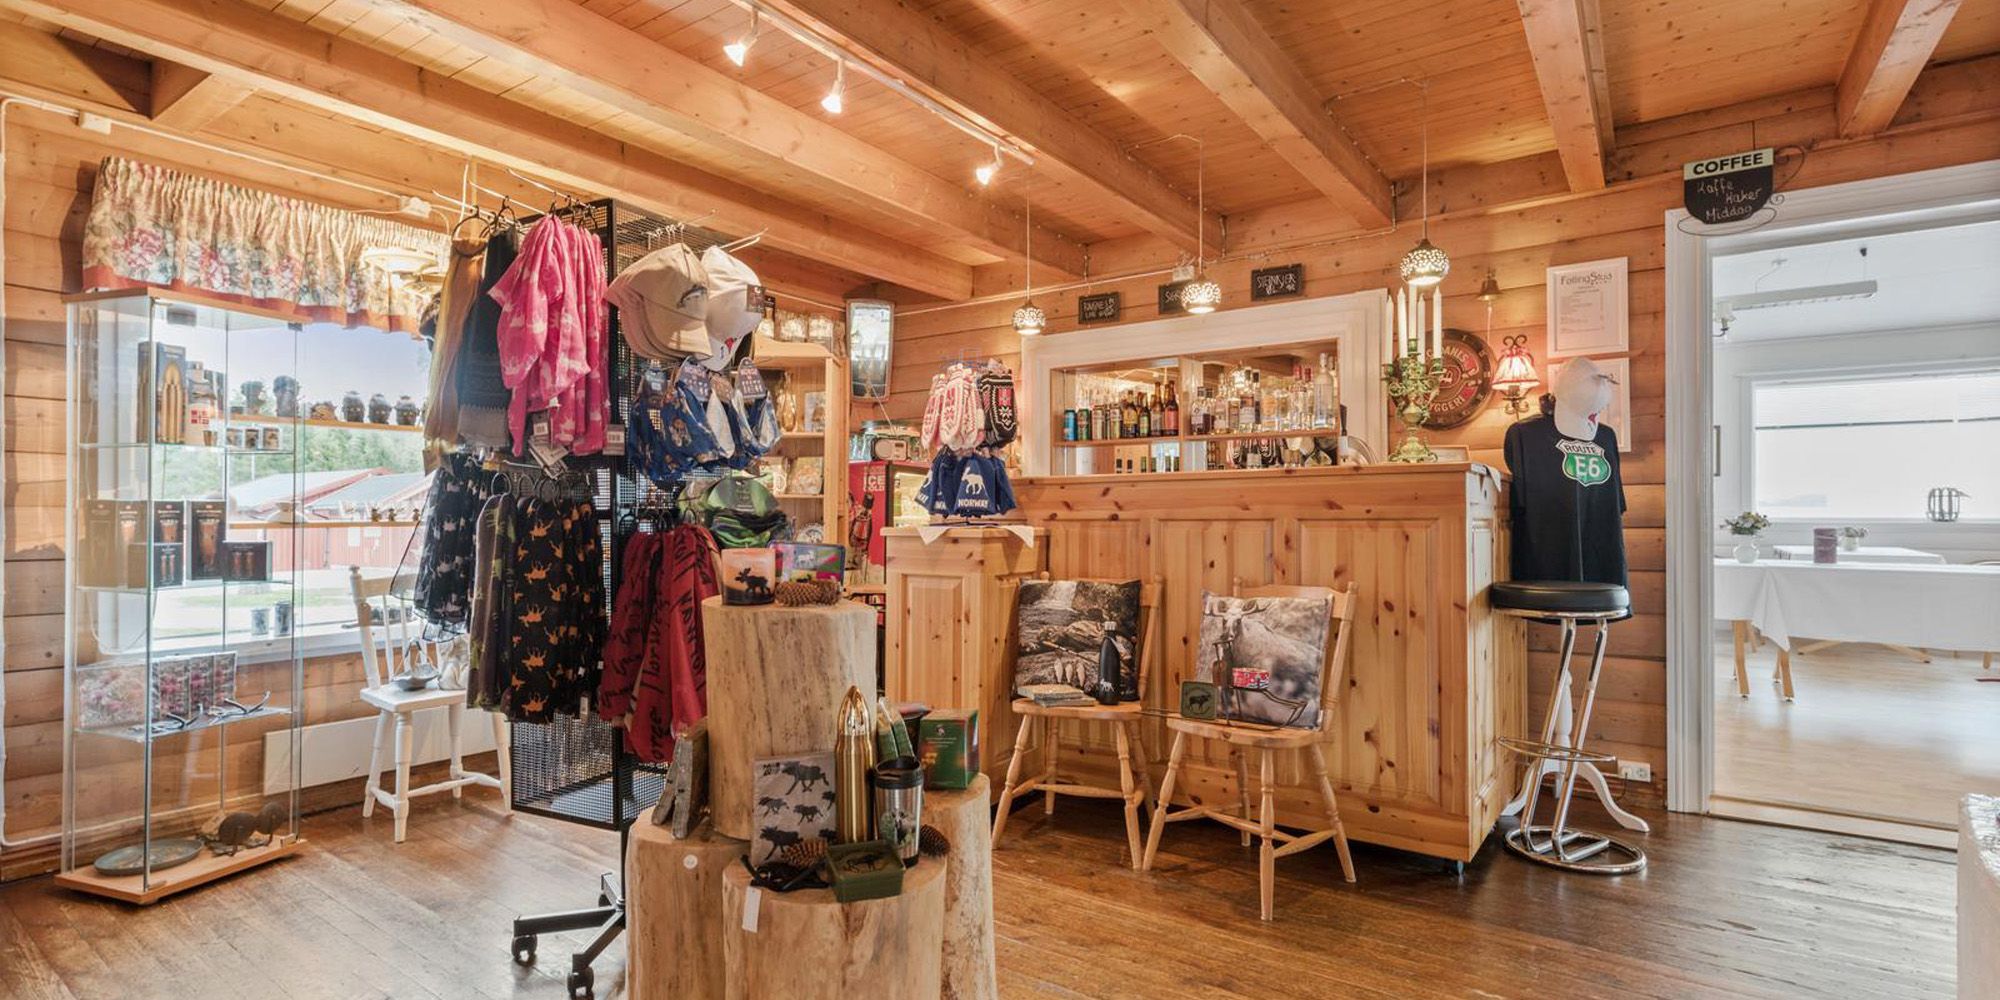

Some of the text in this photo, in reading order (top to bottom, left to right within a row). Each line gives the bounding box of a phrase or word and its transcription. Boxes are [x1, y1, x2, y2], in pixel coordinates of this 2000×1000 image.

[1693, 152, 1763, 175] COFFEE
[1575, 455, 1600, 477] E6
[958, 499, 989, 509] NORWAY
